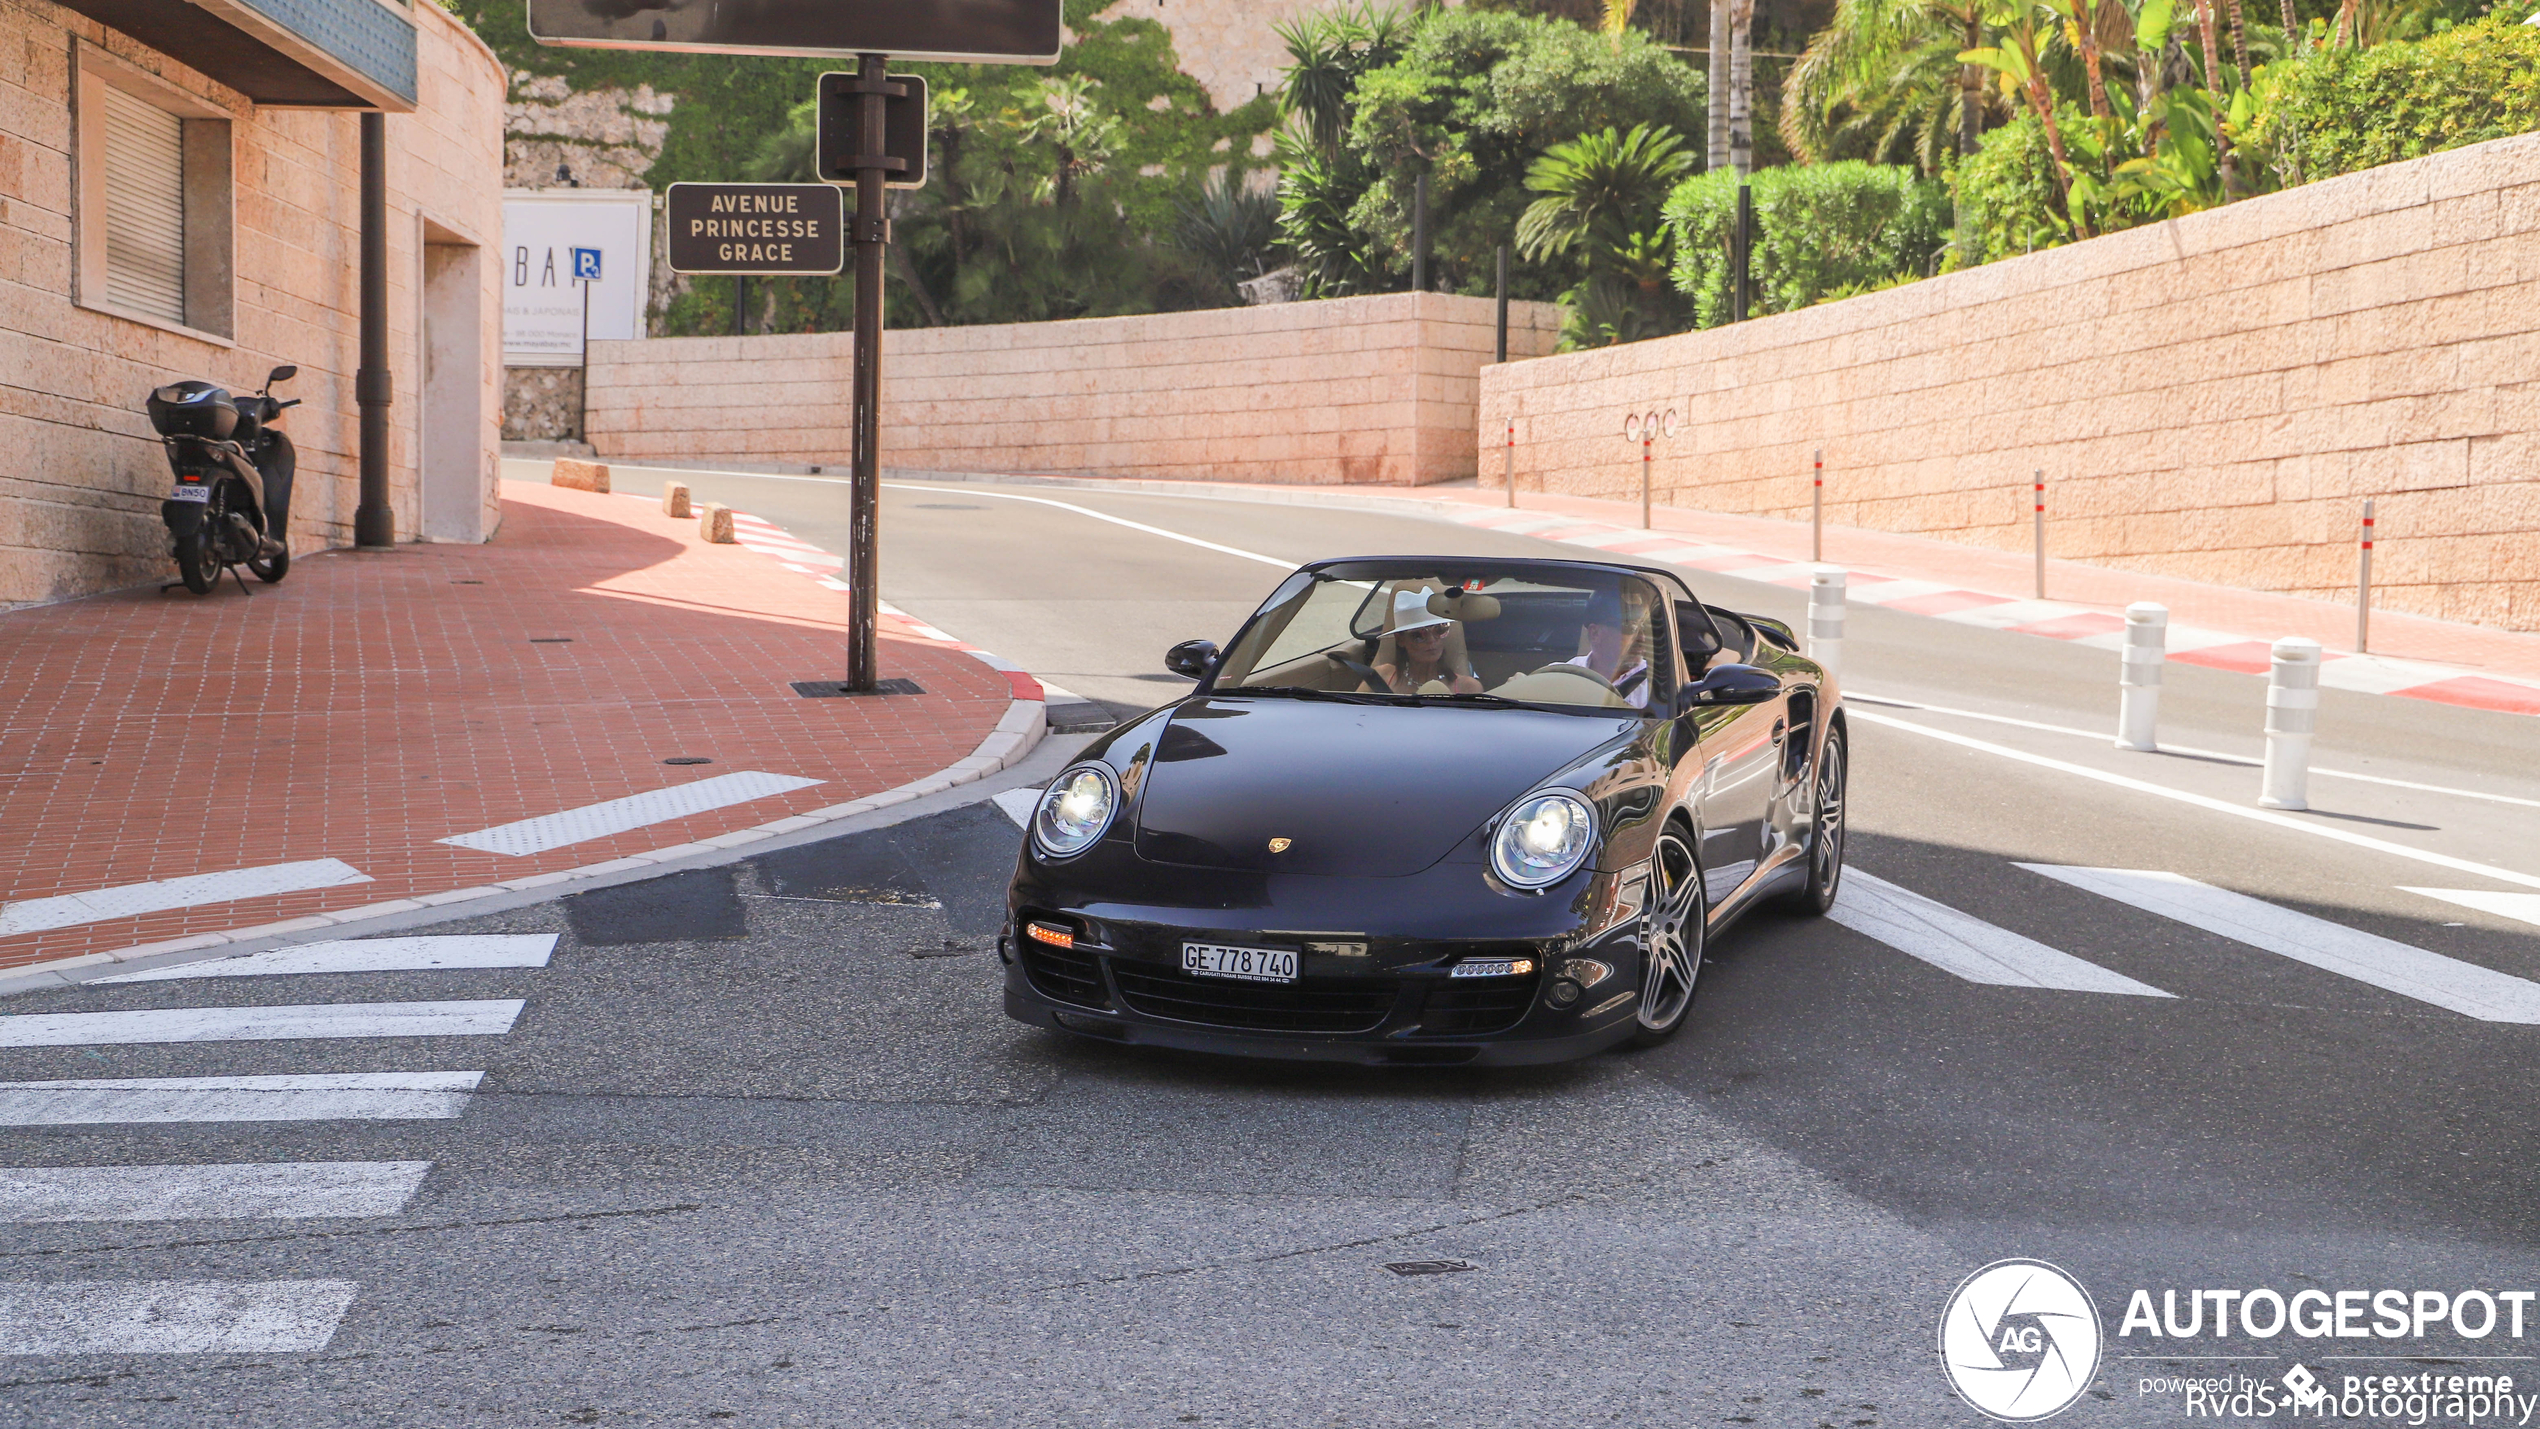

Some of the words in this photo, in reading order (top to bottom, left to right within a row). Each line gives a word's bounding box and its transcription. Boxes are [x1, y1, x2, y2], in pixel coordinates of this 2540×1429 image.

[711, 195, 798, 213] AVENUE
[691, 219, 819, 238] PRINCESSE
[719, 243, 793, 262] GRACE
